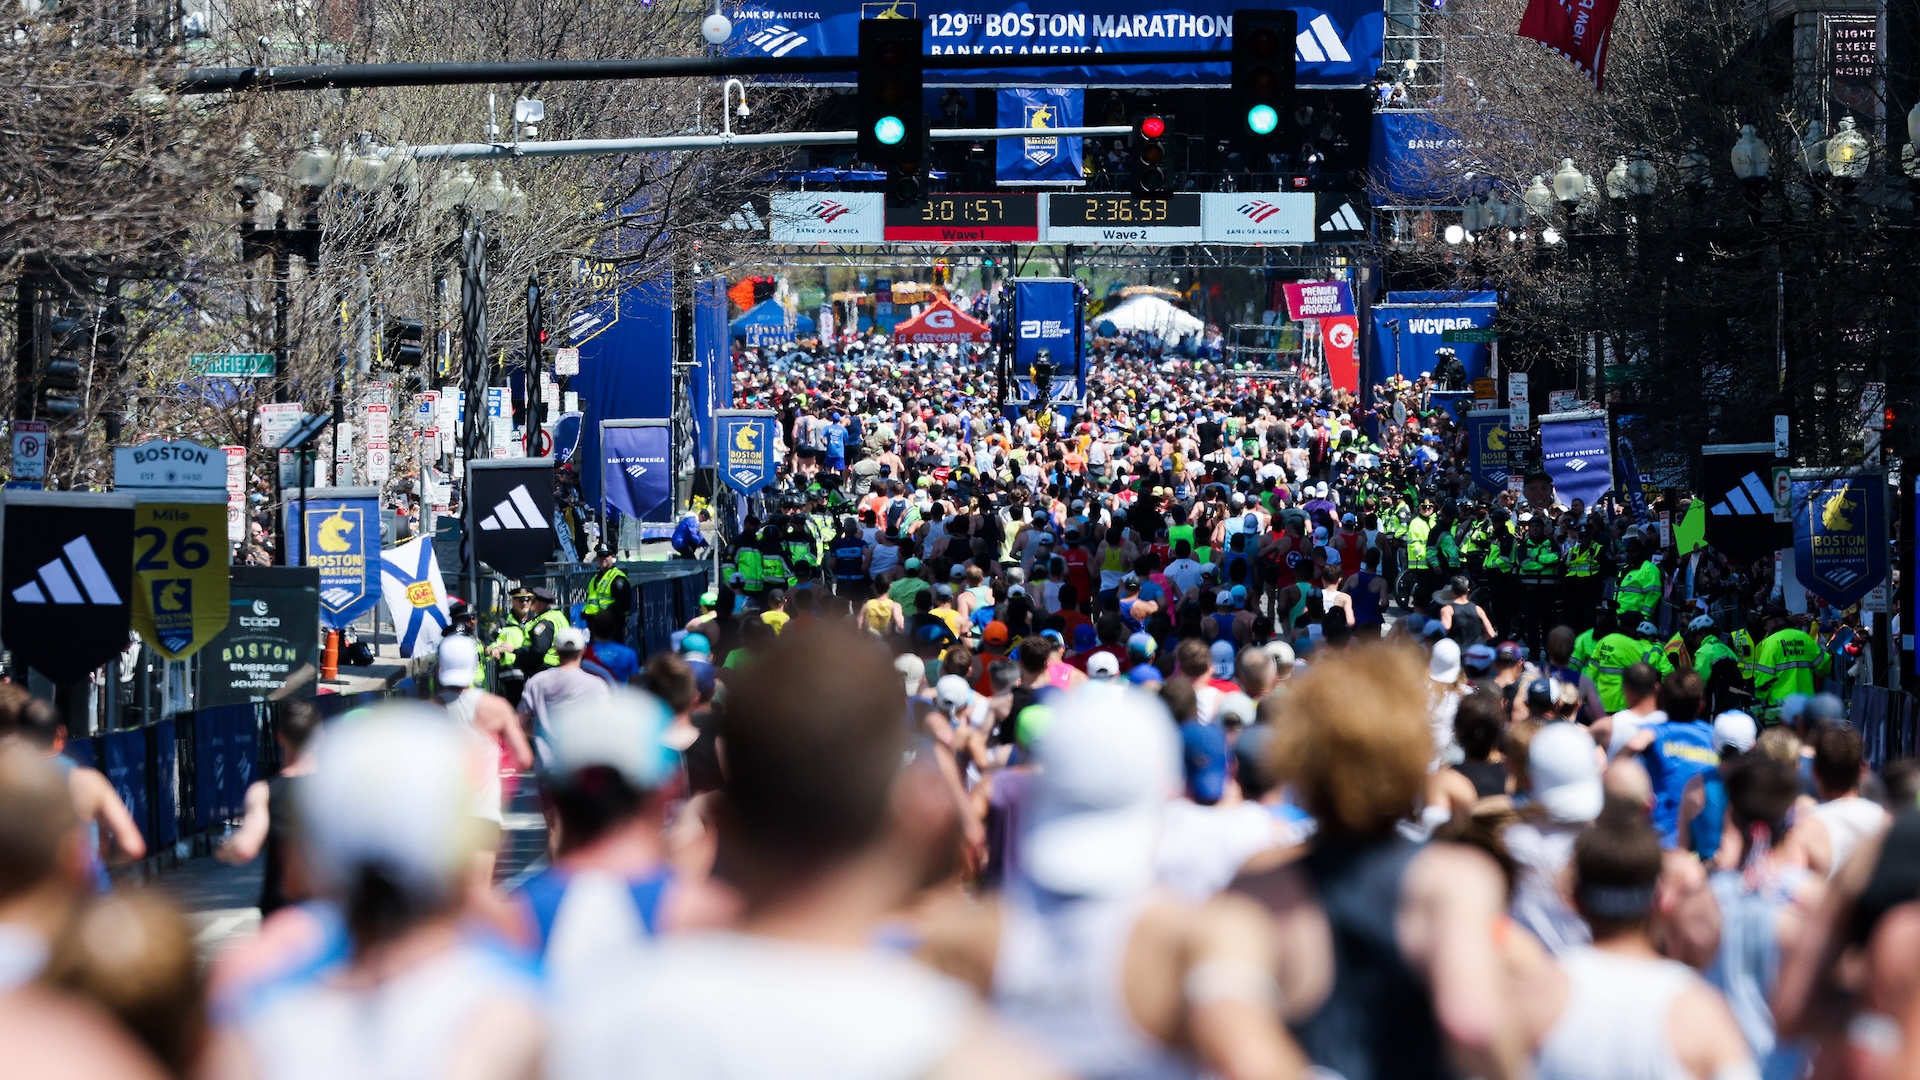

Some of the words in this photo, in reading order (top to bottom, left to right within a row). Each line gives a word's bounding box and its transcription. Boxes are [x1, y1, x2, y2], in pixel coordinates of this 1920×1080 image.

[733, 10, 760, 20] BANK
[761, 10, 776, 20] OF
[776, 11, 821, 20] AMERICA
[928, 13, 983, 37] 129TH
[985, 12, 1086, 38] BOSTON
[1092, 13, 1234, 38] MARATHON
[1407, 139, 1444, 149] BANK
[922, 200, 1003, 222] 3:01:57
[1085, 199, 1168, 221] 2:36:53
[942, 229, 977, 240] Wave
[1103, 229, 1138, 240] Wave
[1140, 230, 1148, 240] 2
[1301, 285, 1339, 297] PREMIER
[1304, 295, 1338, 305] RUNNER
[1300, 303, 1342, 316] PROGRAM
[1408, 317, 1456, 335] WCVB
[912, 333, 973, 343] GATORADE
[1454, 332, 1483, 342] EXETER
[133, 446, 209, 465] BOSTON
[730, 450, 762, 459] BOSTON
[1482, 452, 1508, 460] BOSTO
[1545, 452, 1565, 460] BANK
[1574, 448, 1605, 457] AMERICA
[153, 509, 191, 521] Mile
[1814, 535, 1865, 547] BOSTON
[133, 526, 211, 572] 26
[1815, 547, 1866, 556] MARATHON
[310, 554, 363, 567] BOSTON
[319, 567, 363, 576] ARATHON
[1781, 638, 1805, 650] Boston
[222, 642, 297, 662] BOSTON
[1783, 647, 1806, 658] Police
[229, 663, 290, 673] EMBRACE
[247, 672, 271, 680] THE
[229, 680, 287, 689] JOURNEY
